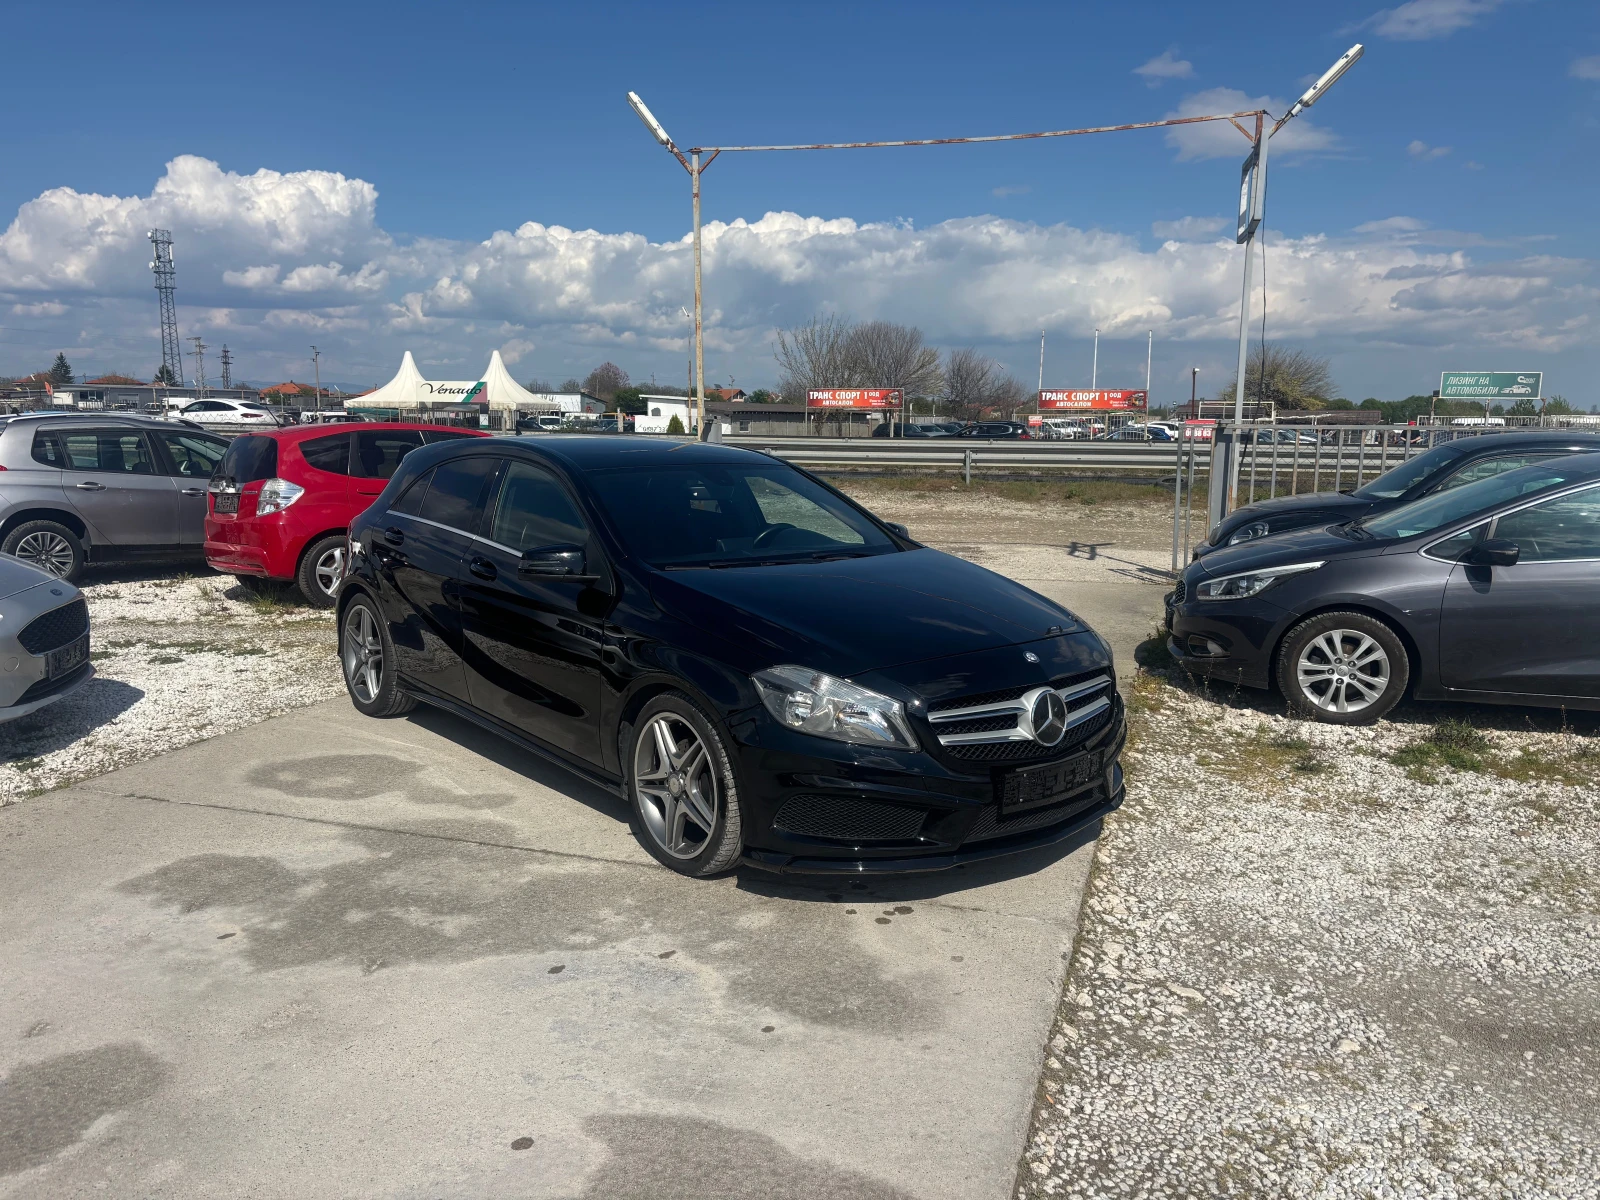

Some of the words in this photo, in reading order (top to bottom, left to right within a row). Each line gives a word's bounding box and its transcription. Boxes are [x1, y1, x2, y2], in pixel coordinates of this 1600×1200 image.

[420, 383, 482, 394] Venauto
[1041, 392, 1068, 400] ТРАНС
[1071, 392, 1100, 400] СПОРТ
